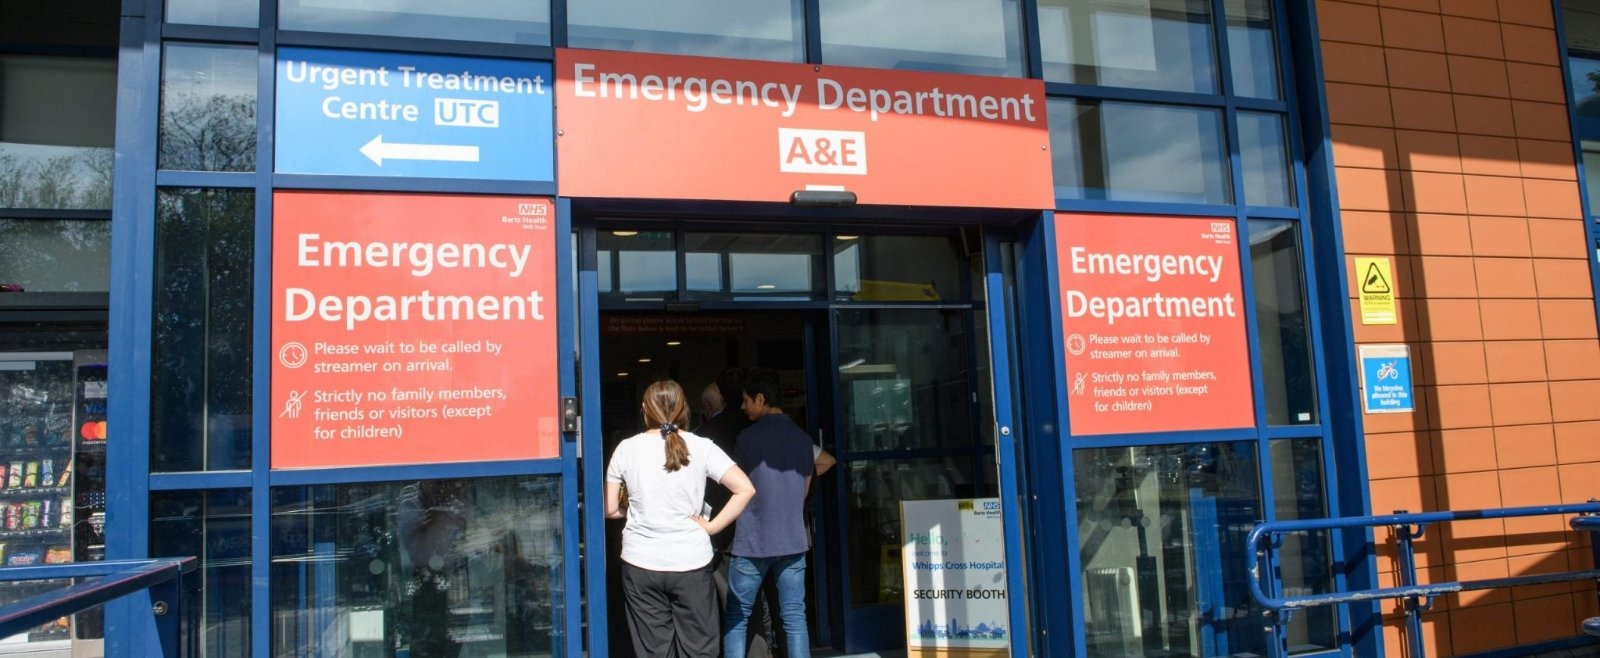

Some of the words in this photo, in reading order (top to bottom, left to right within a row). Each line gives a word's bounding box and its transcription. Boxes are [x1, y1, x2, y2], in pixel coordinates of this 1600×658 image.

[286, 60, 389, 90] Urgent
[398, 65, 545, 95] Treatment
[573, 62, 801, 117] Emergency
[816, 78, 1036, 122] Department
[321, 95, 420, 122] Centre
[438, 101, 496, 125] UTC
[786, 136, 858, 167] A&E
[520, 204, 545, 214] NHS
[1212, 224, 1229, 232] NHS
[297, 233, 531, 277] Emergency
[1071, 247, 1223, 282] Emergency
[285, 287, 544, 331] Department
[1067, 291, 1236, 324] Department
[1089, 334, 1118, 344] Please
[1121, 334, 1141, 344] wait
[1144, 335, 1154, 344] to
[1157, 334, 1168, 343] be
[1171, 333, 1197, 343] called
[1200, 333, 1211, 345] by
[314, 342, 359, 355] Please
[364, 342, 394, 354] wait
[400, 343, 414, 354] to
[419, 342, 437, 353] be
[441, 341, 481, 352] called
[486, 341, 502, 355] by
[1090, 349, 1132, 359] streamer
[1135, 349, 1148, 358] on
[1150, 348, 1180, 357] arrival.
[314, 362, 377, 373] streamer
[383, 362, 401, 371] on
[406, 359, 453, 371] arrival.
[1092, 372, 1124, 384] Strictly
[1127, 373, 1140, 382] no
[1142, 371, 1170, 382] family
[1172, 370, 1217, 381] members,
[314, 389, 363, 404] Strictly
[368, 391, 386, 401] no
[391, 388, 434, 403] family
[438, 387, 506, 400] members,
[1093, 386, 1127, 397] friends
[1129, 387, 1139, 396] or
[1142, 385, 1173, 395] visitors
[1176, 383, 1208, 396] (except
[314, 408, 364, 421] friends
[369, 410, 384, 420] or
[389, 407, 437, 419] visitors
[442, 404, 491, 418] (except
[1095, 403, 1109, 412] for
[1111, 401, 1152, 412] children)
[314, 427, 336, 439] for
[340, 424, 402, 439] children)
[910, 532, 948, 546] Hello,
[912, 561, 944, 571] Whipps
[945, 561, 968, 570] Cross
[969, 561, 1004, 571] Hospital
[913, 589, 963, 600] SECURITY
[966, 589, 1005, 600] BOOTH
